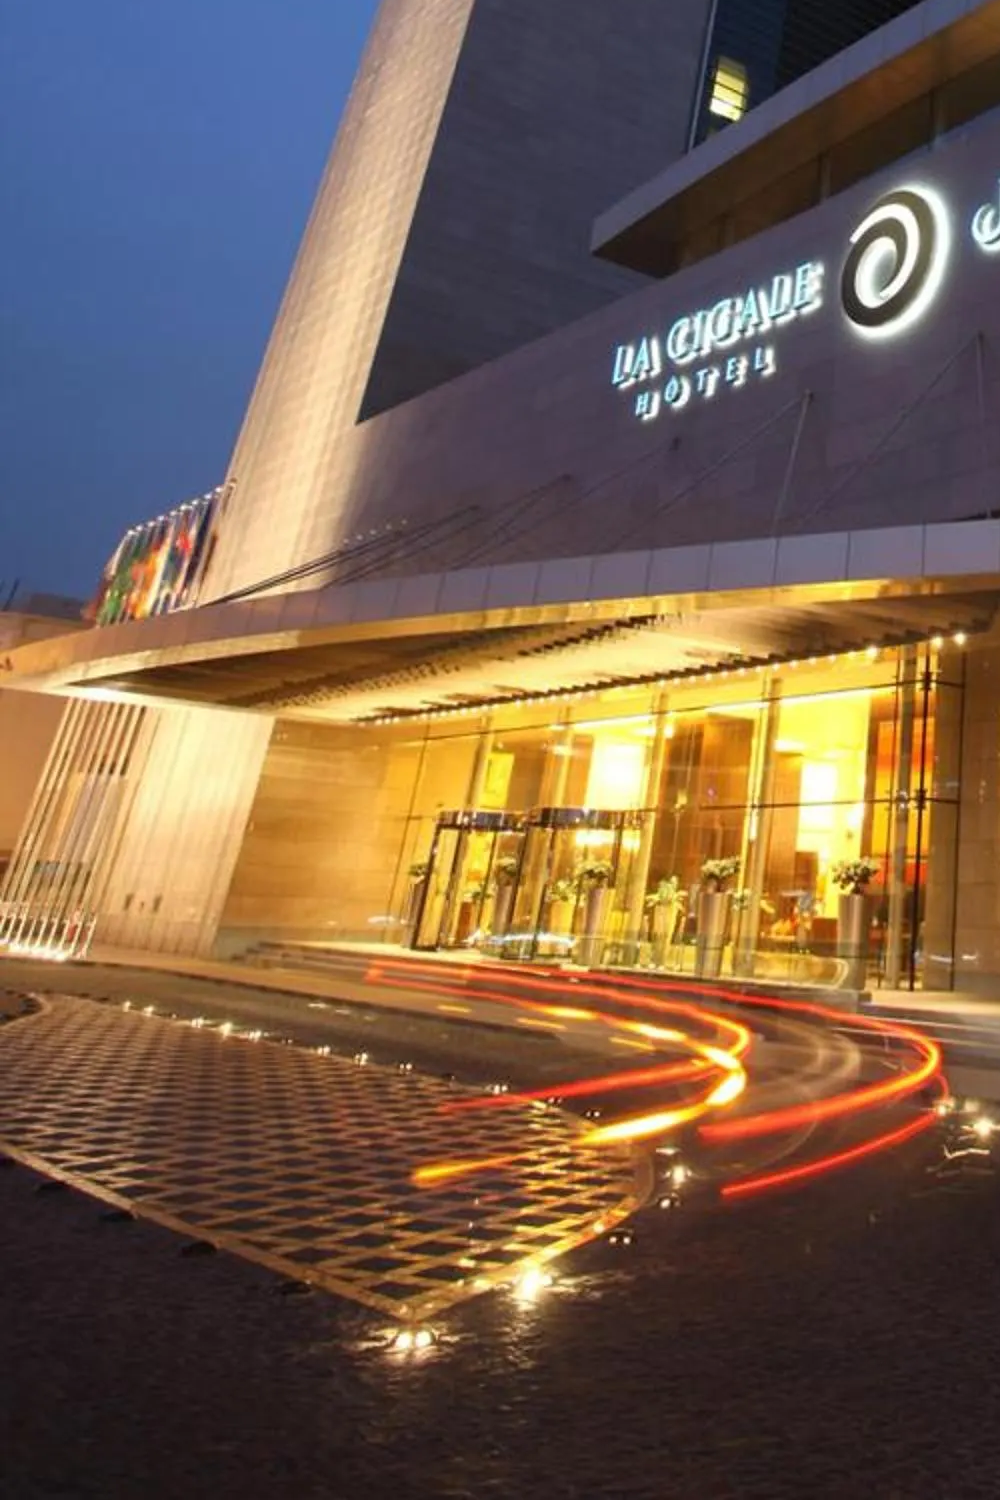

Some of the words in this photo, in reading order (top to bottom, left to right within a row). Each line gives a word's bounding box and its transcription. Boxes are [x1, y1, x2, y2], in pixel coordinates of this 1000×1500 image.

[612, 336, 661, 389] LA
[666, 261, 824, 365] CIGALE
[634, 347, 775, 420] HOTEL
